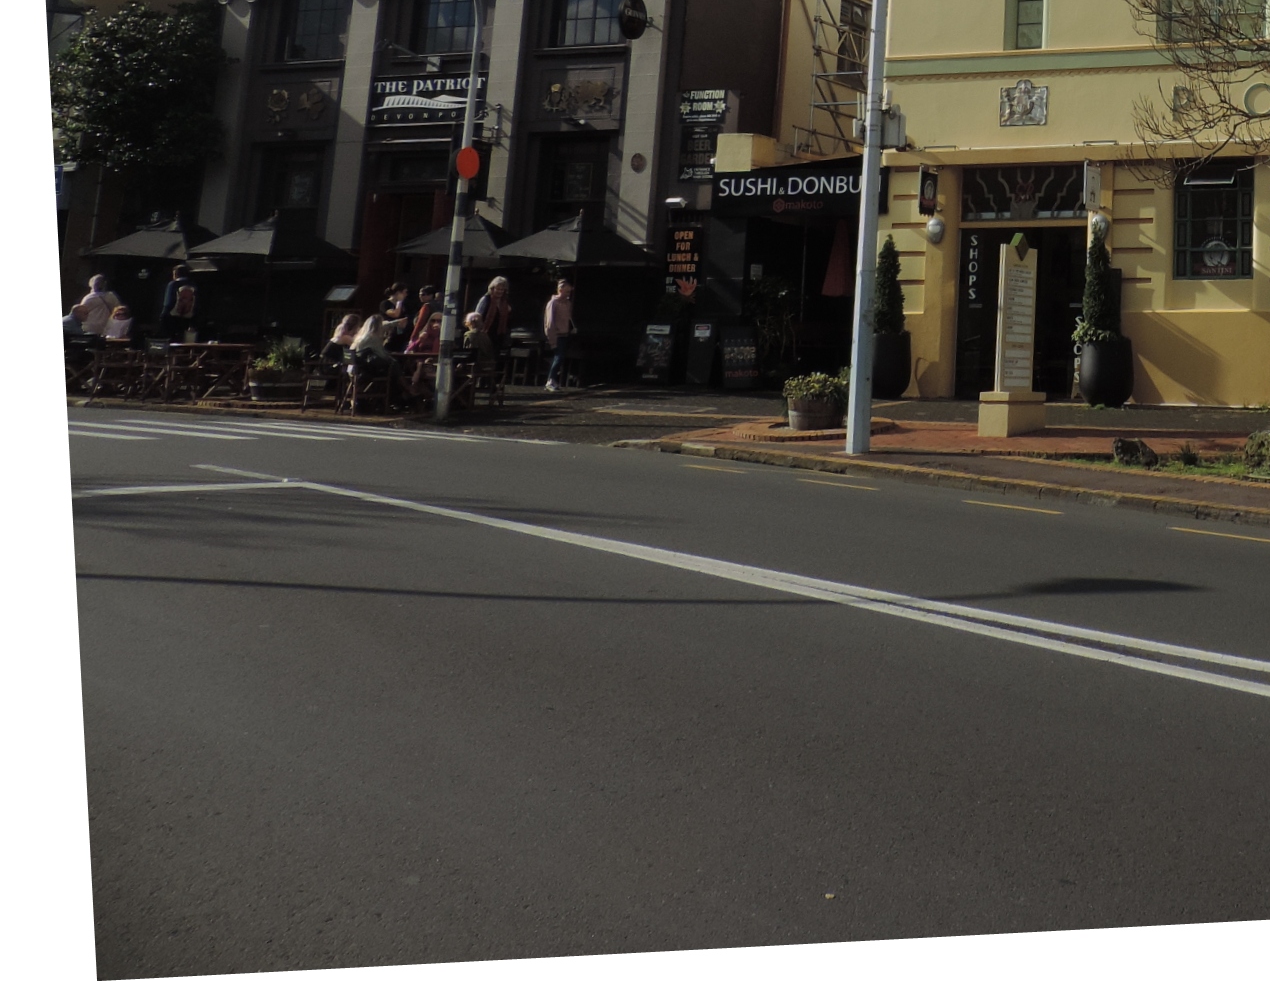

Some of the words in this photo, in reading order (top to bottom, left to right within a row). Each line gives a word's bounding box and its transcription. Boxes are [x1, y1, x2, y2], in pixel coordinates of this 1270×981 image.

[374, 81, 407, 93] THE
[690, 90, 725, 99] FUNCTION
[692, 101, 713, 111] ROOM
[370, 110, 457, 121] DEVONPO
[719, 177, 776, 197] SUSHI
[785, 200, 824, 210] makoto
[674, 231, 694, 240] OPEN
[676, 242, 691, 251] FOR
[667, 253, 692, 262] LUNCH
[669, 264, 696, 273] DINNER
[968, 234, 979, 299] SHOPS
